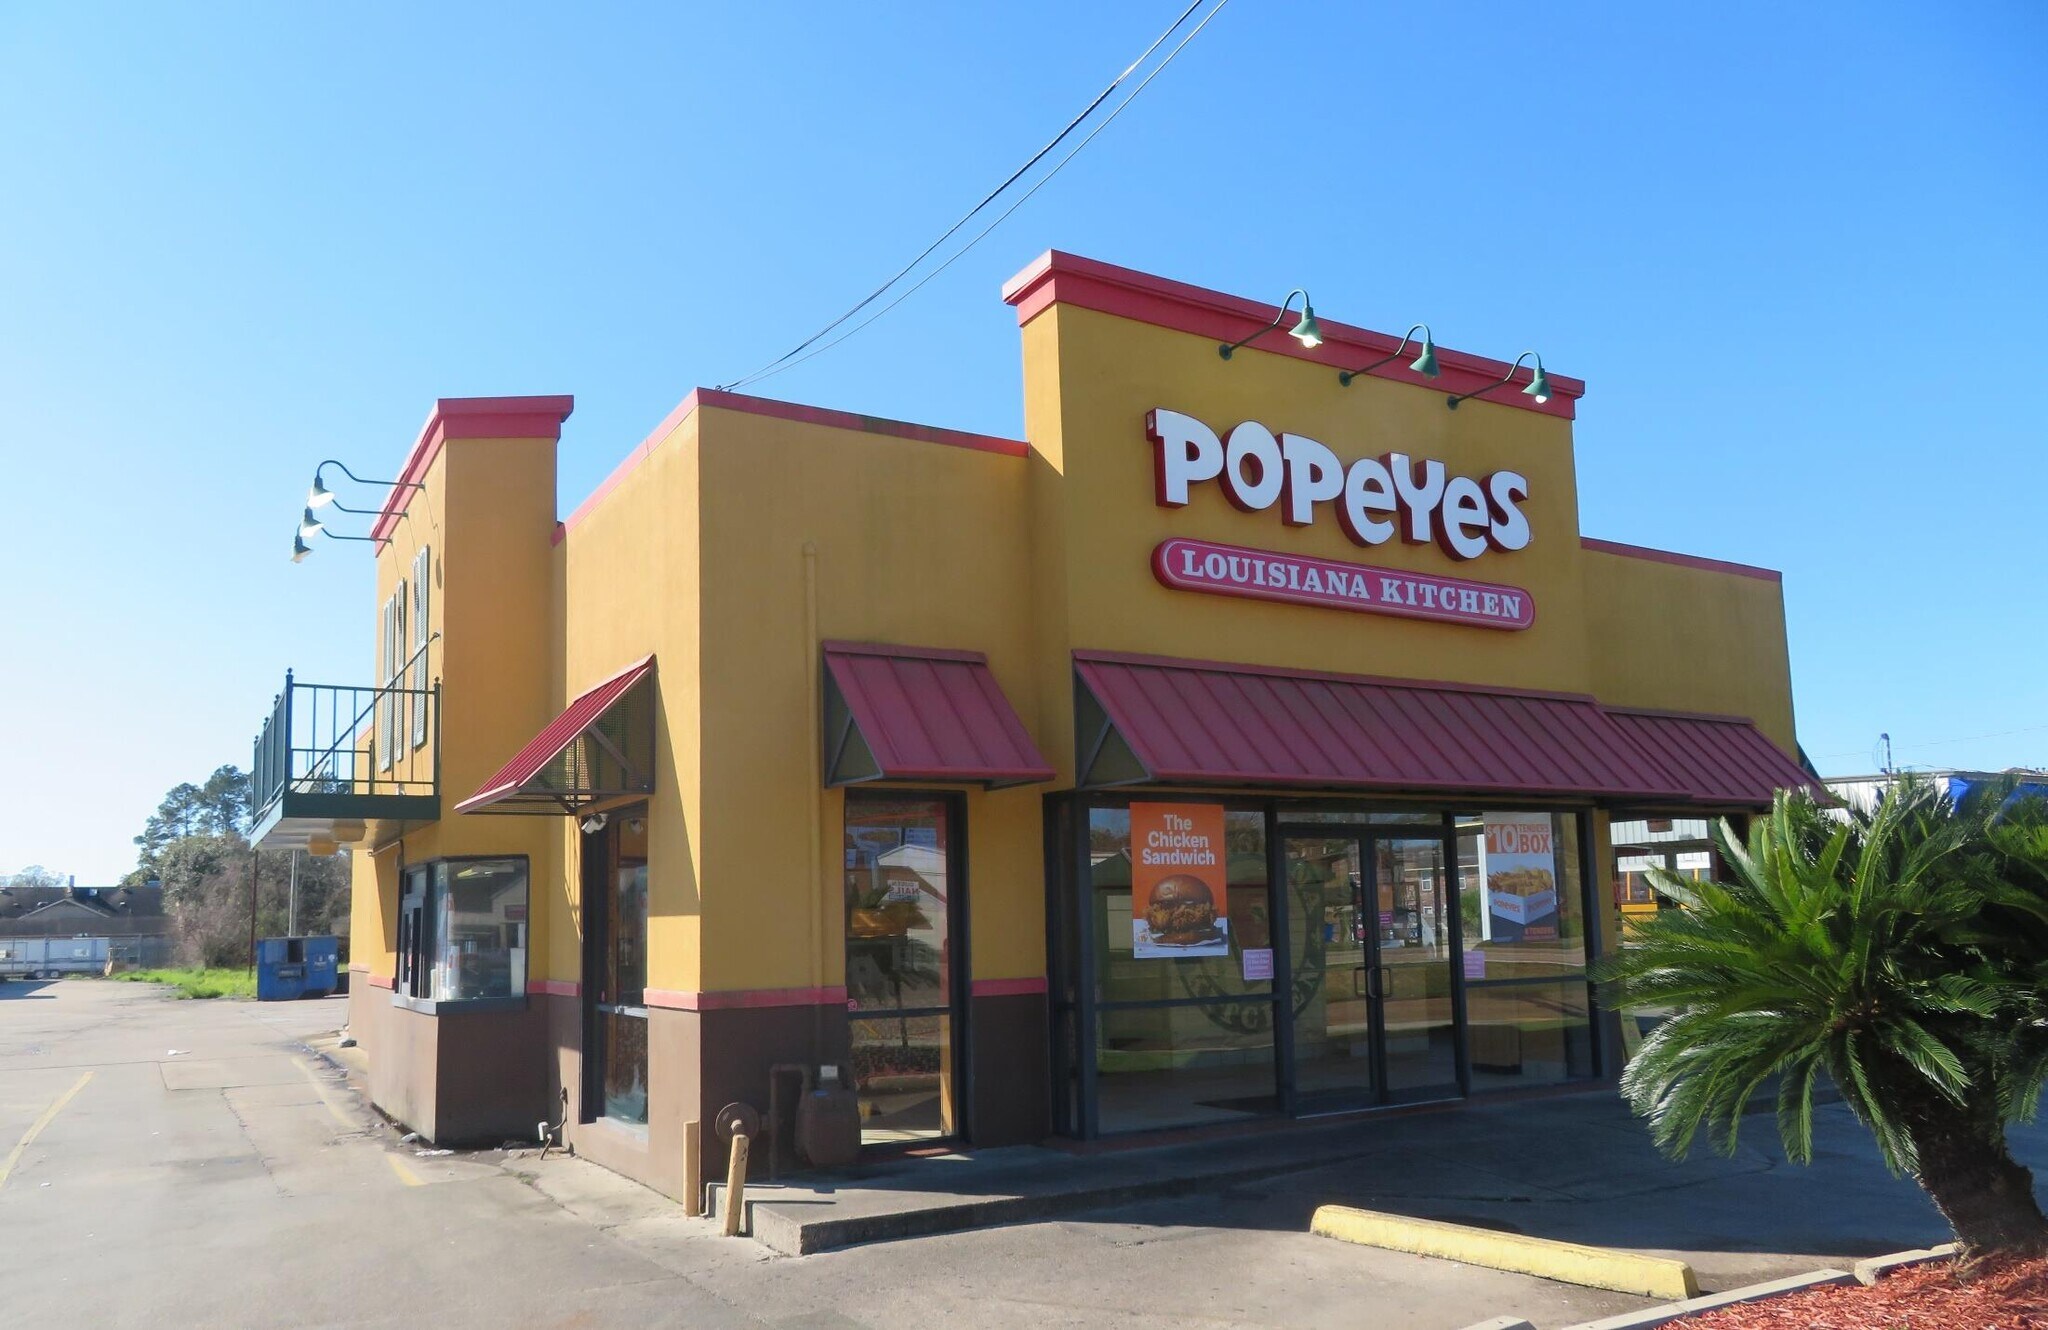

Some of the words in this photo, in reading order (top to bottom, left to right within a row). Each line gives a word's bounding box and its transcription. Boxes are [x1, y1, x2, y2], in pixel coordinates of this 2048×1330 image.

[1181, 549, 1370, 599] LOUISIANA
[1380, 578, 1522, 620] KITCHEN
[1163, 814, 1193, 831] The
[1148, 831, 1209, 849] Chicken
[1487, 824, 1518, 854] $10
[1519, 835, 1551, 854] BOX
[1142, 848, 1216, 865] Sandwich
